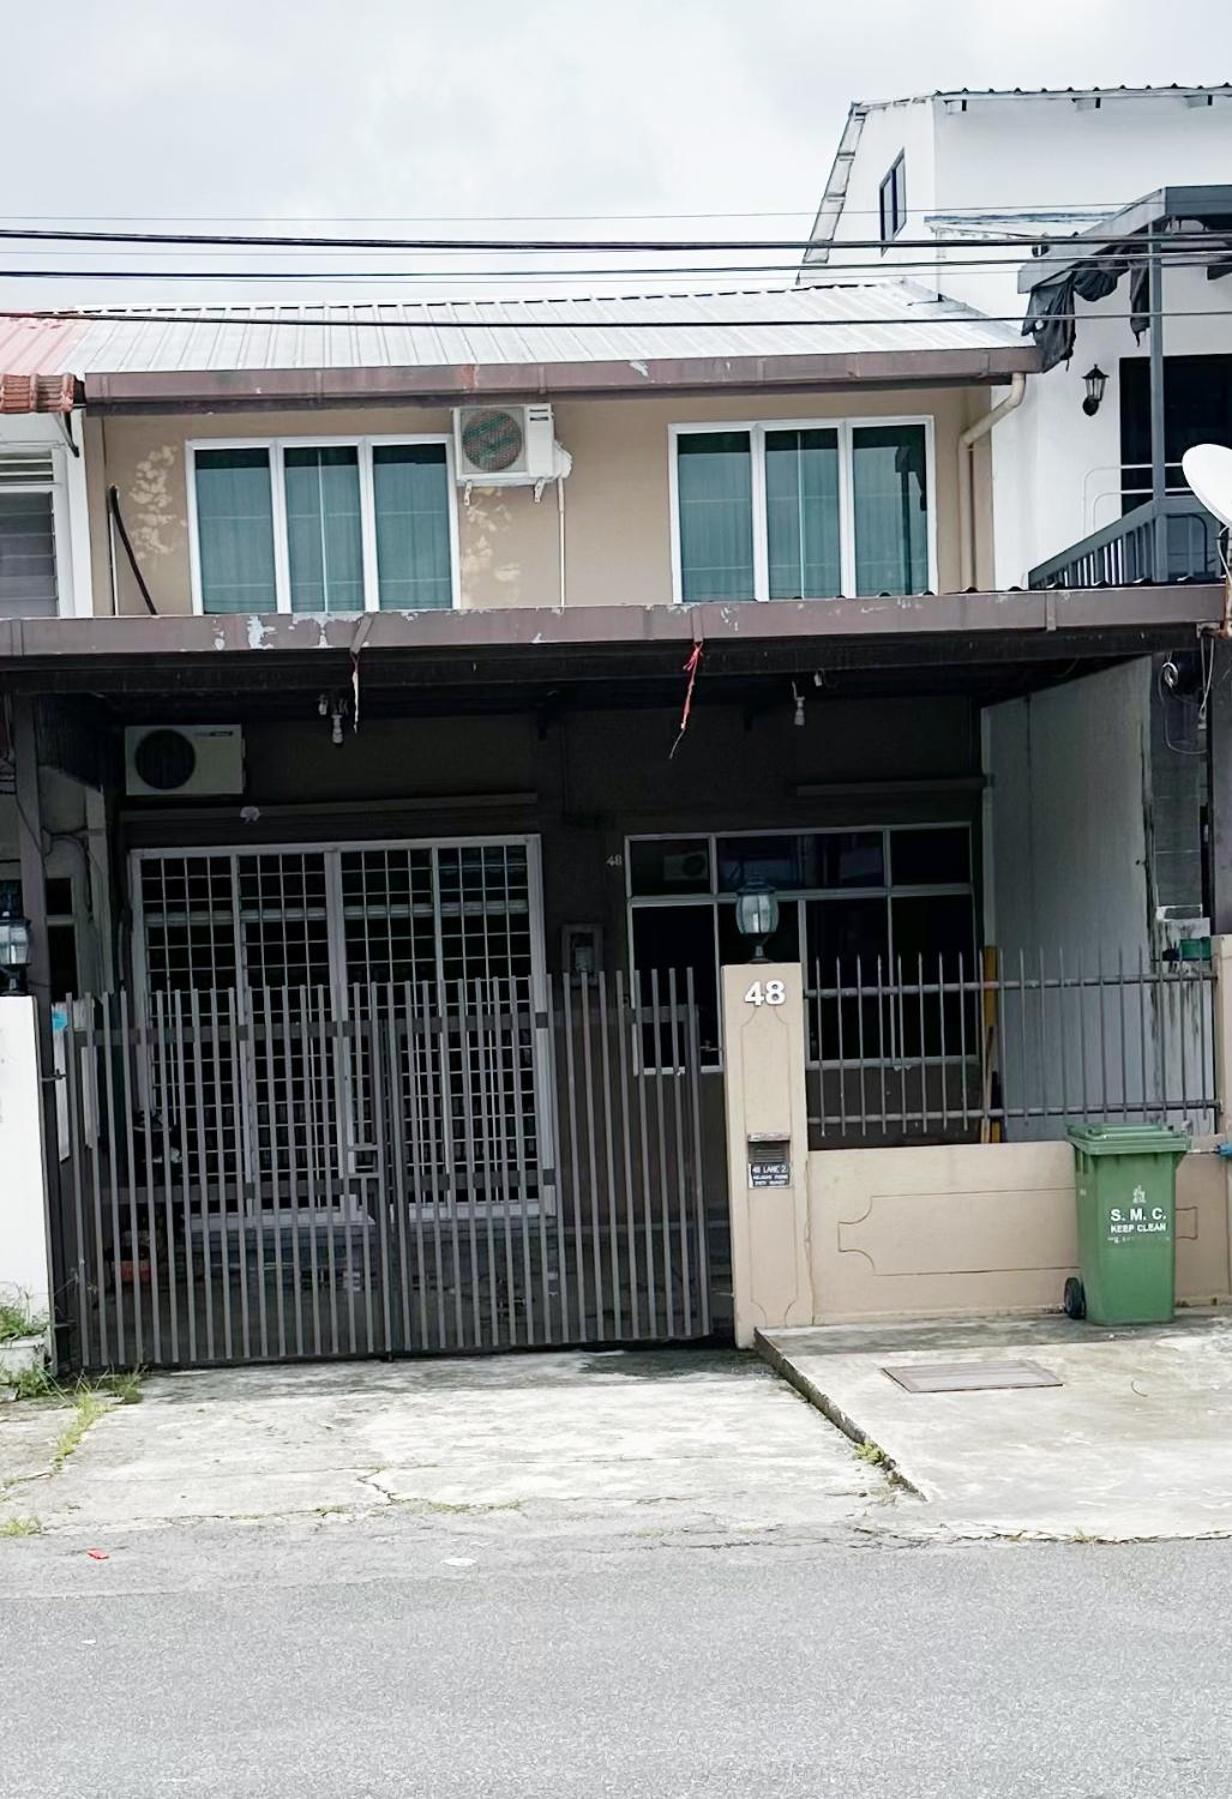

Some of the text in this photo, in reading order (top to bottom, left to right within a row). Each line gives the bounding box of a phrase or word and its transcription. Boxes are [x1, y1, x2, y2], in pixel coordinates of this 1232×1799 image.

[744, 980, 785, 1006] 48
[1110, 1222, 1167, 1234] KEEP CLEAN
